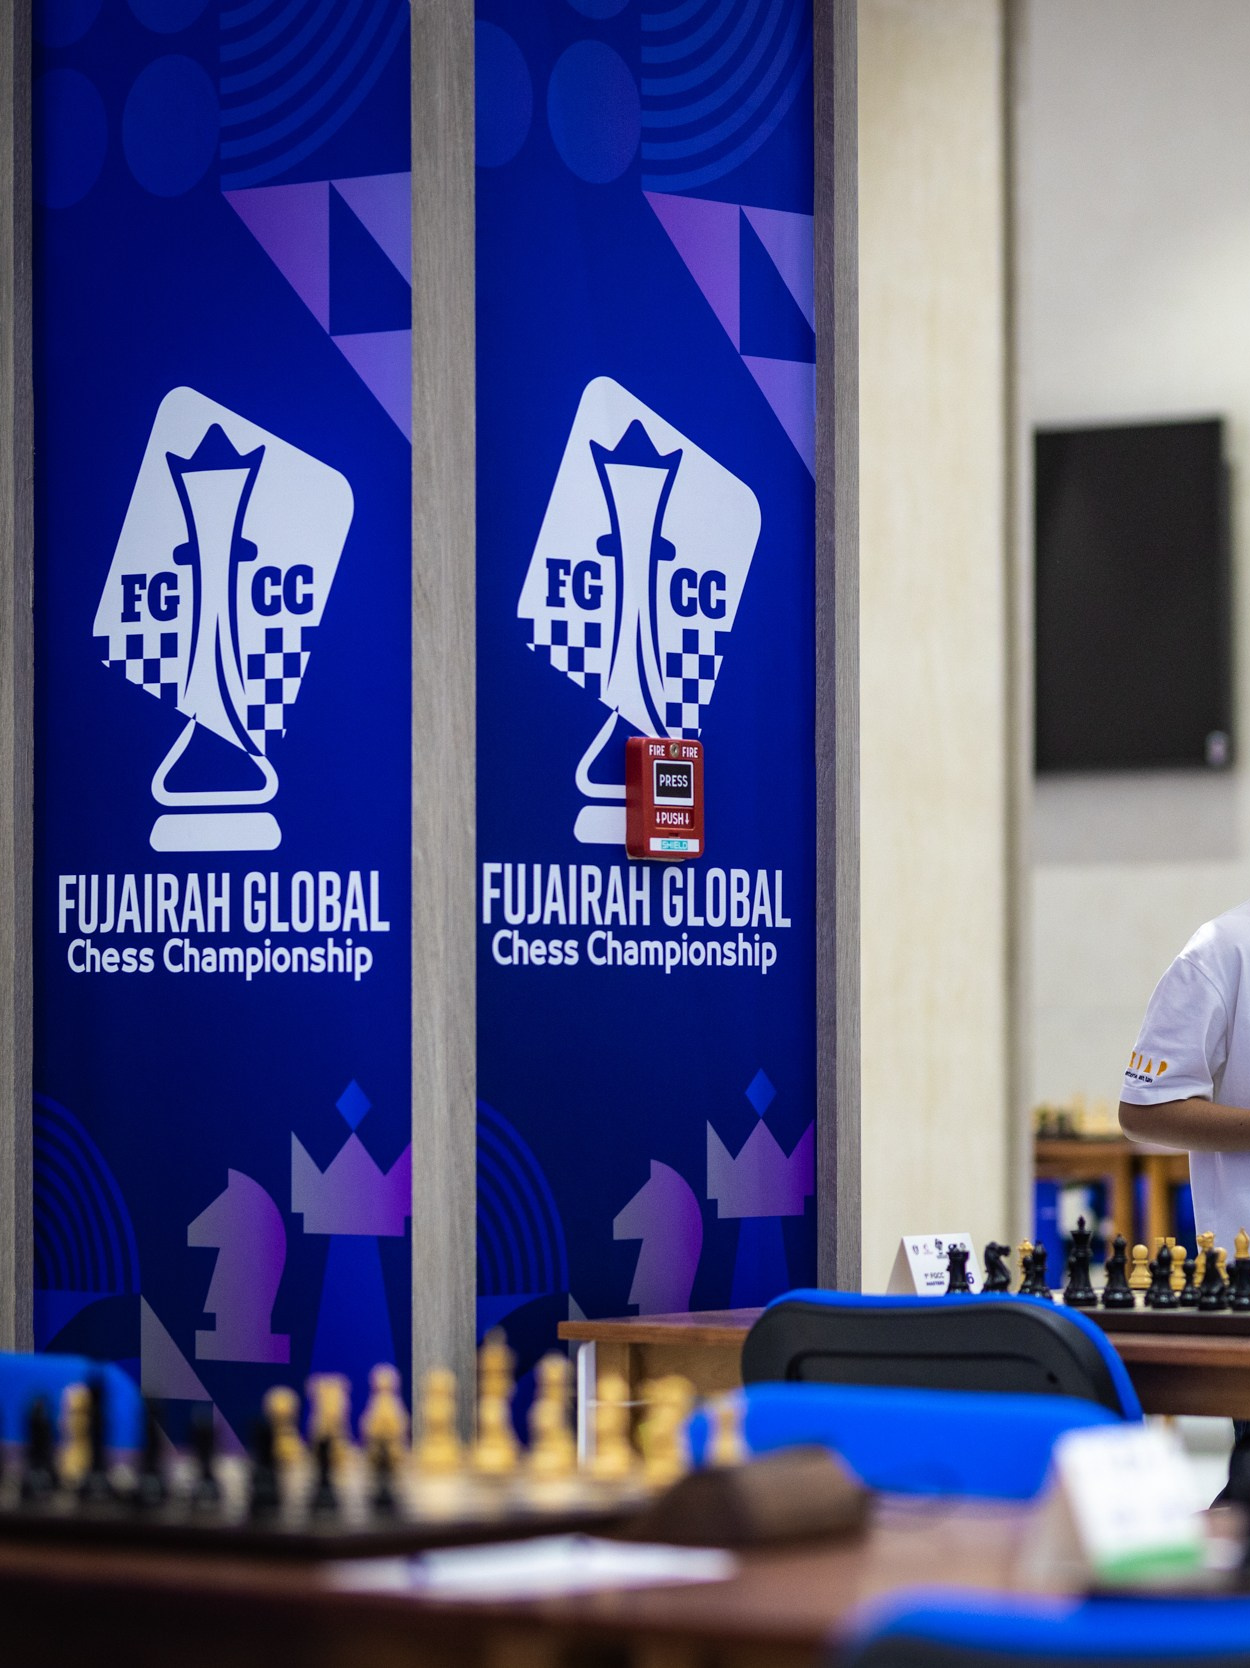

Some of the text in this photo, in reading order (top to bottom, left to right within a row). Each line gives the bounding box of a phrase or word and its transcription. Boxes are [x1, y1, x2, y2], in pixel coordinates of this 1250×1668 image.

[121, 564, 314, 623] FG CC
[546, 557, 727, 620] FG CC
[649, 744, 699, 758] FIRE FIRE
[659, 773, 688, 787] PRESS
[661, 812, 684, 825] PUSH
[661, 840, 688, 850] SHIELD
[58, 870, 391, 934] FUJAIRAH GLOBAL
[482, 862, 792, 928] FUJAIRAH GLOBAL
[67, 937, 374, 981] Chess Championship
[492, 929, 778, 974] Chess Championship
